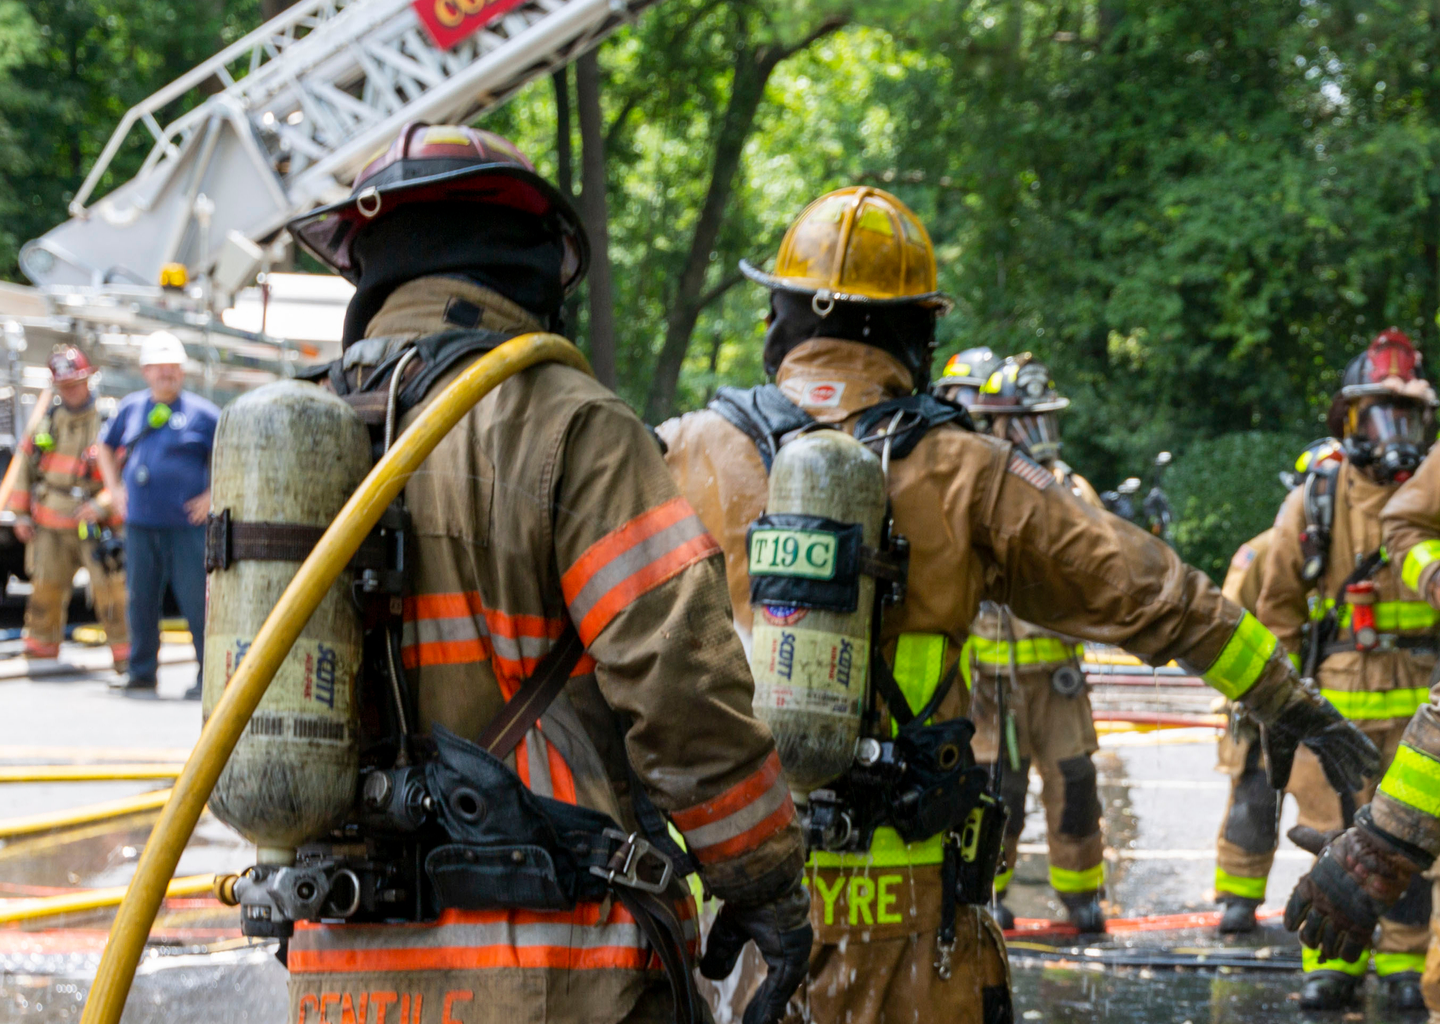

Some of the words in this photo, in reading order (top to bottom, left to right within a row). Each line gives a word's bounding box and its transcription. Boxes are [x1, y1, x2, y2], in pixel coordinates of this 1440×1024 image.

[315, 642, 336, 710] SCOTT
[777, 630, 796, 682] SCOTT
[837, 638, 854, 690] SCOTT
[801, 874, 903, 926] YRE
